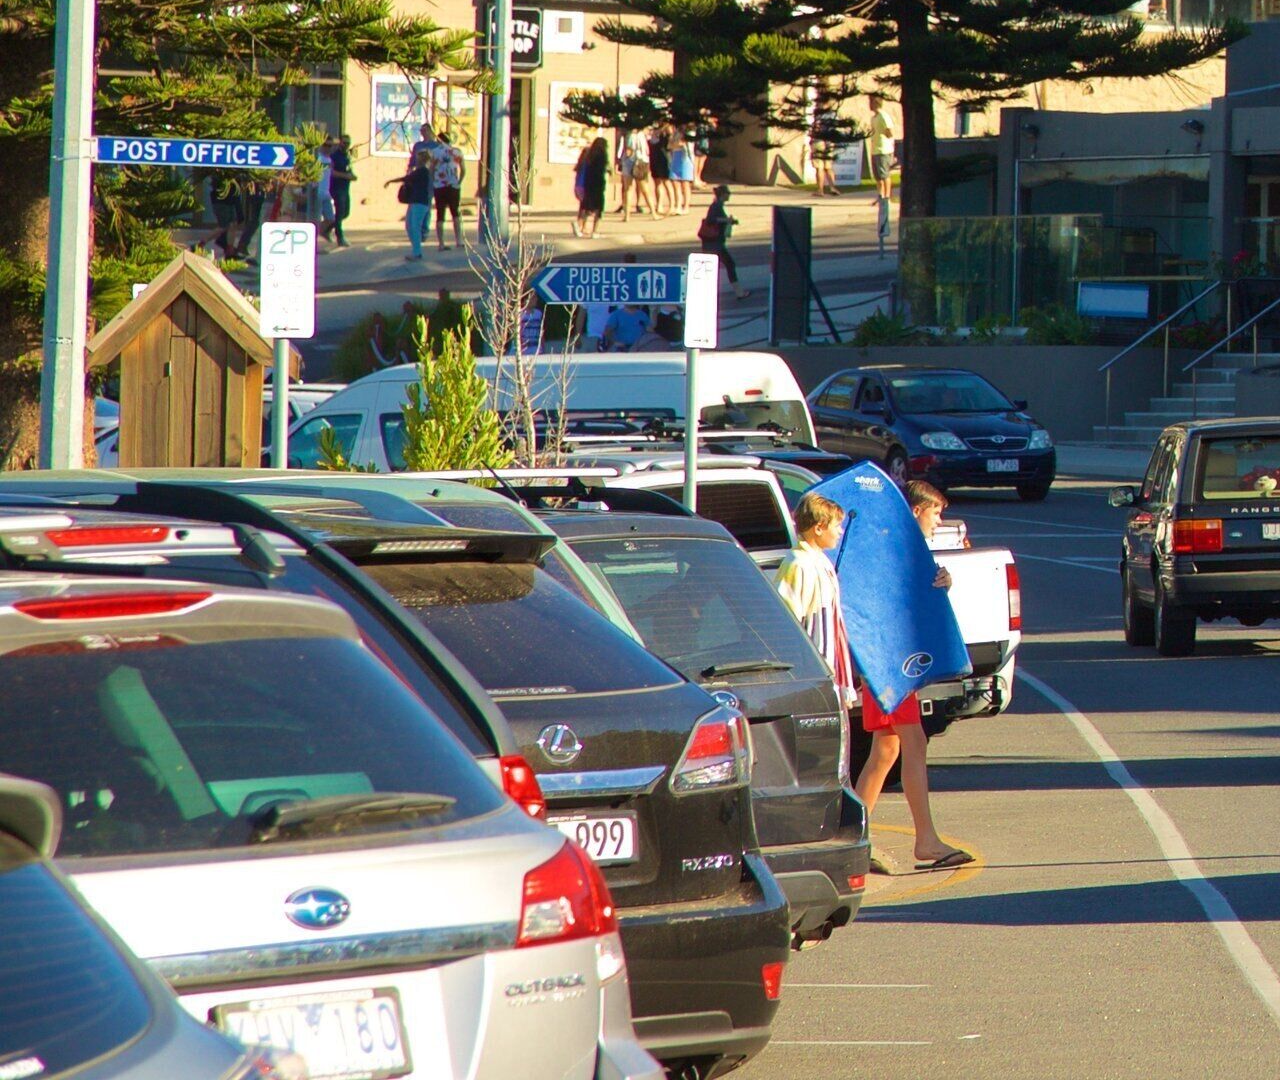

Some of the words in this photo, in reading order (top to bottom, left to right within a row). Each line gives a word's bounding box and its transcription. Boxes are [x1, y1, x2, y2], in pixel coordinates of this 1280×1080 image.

[112, 140, 172, 161] POST
[182, 143, 261, 166] OFFICE
[268, 229, 309, 255] 2P
[569, 267, 627, 284] PUBLIC
[566, 284, 630, 302] TOILETS
[1230, 506, 1280, 514] RANGE
[682, 857, 703, 871] RX
[333, 1003, 398, 1057] 180
